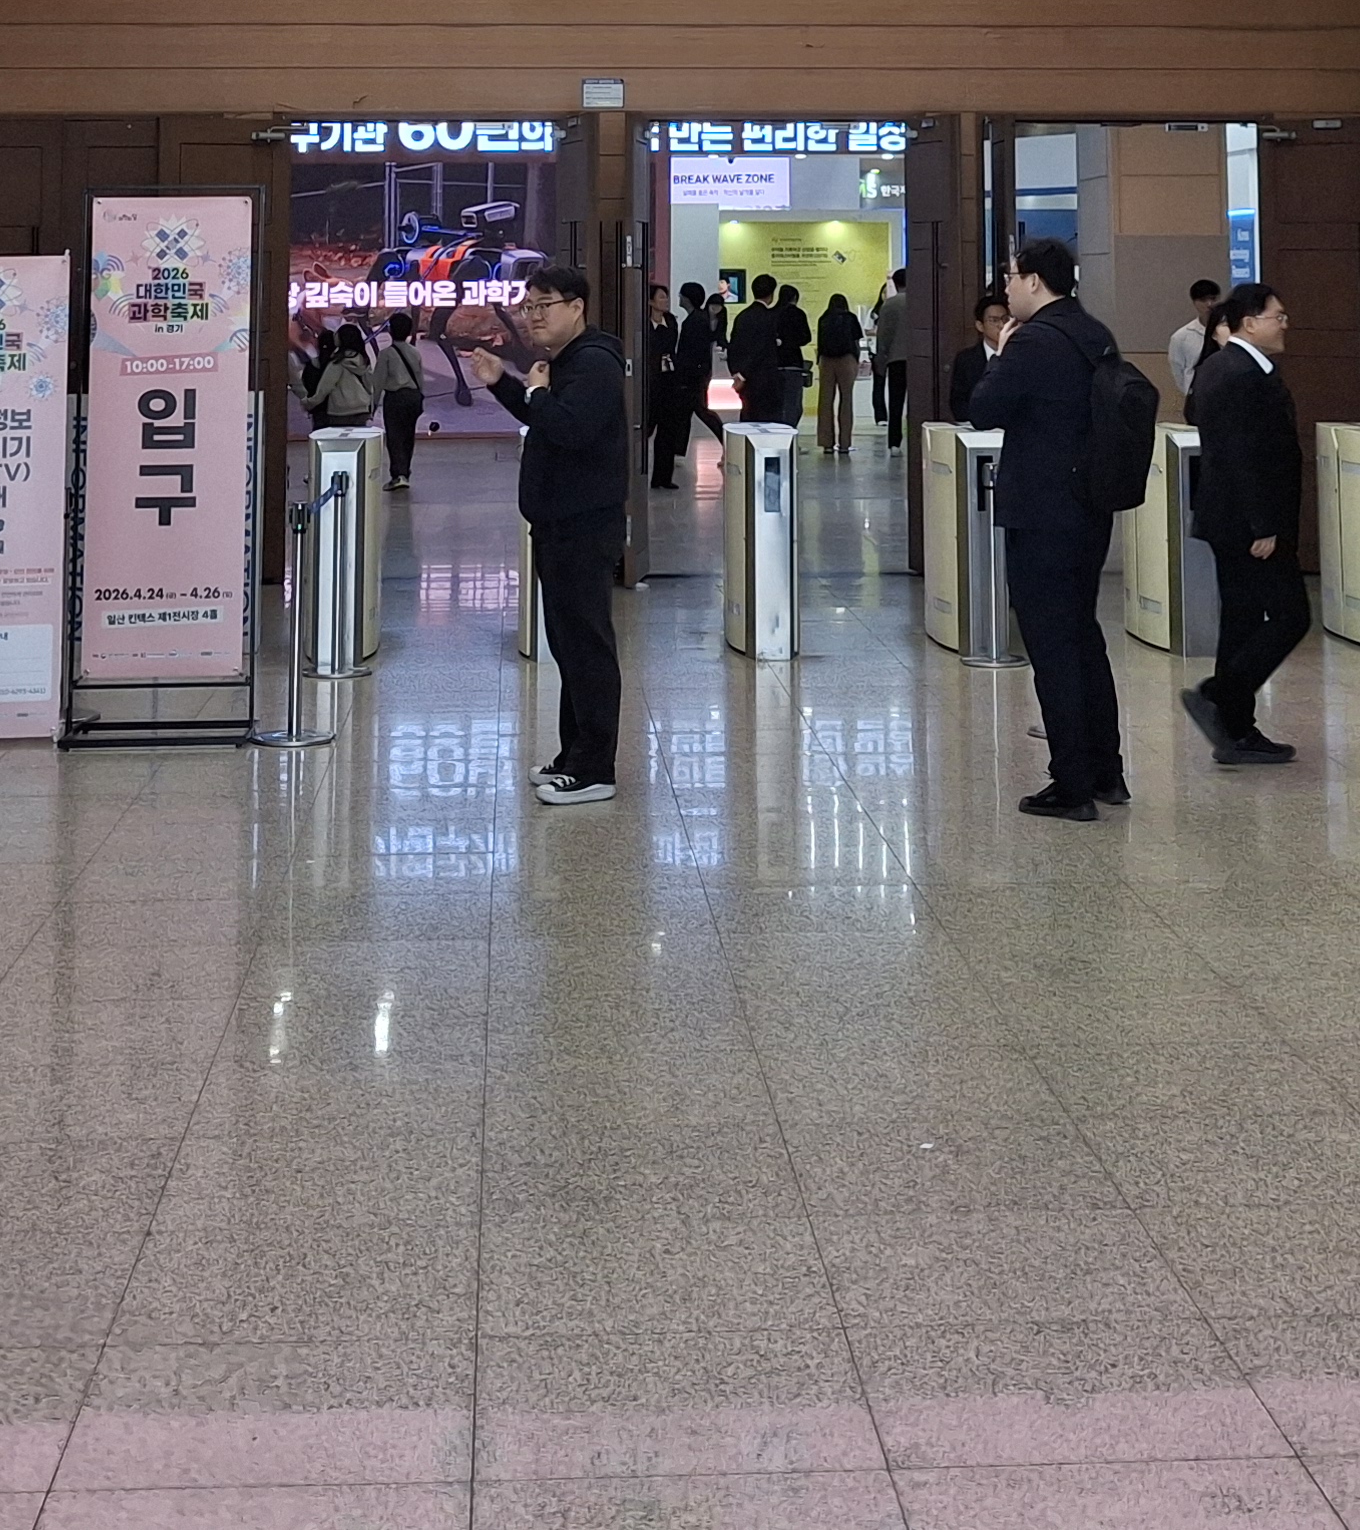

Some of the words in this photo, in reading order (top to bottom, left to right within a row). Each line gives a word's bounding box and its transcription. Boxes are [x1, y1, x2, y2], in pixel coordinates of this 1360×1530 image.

[673, 174, 710, 185] BREAK
[712, 174, 743, 184] WAVE
[745, 173, 775, 184] ZONE
[152, 268, 189, 280] 2026
[136, 282, 204, 300] 대한민국
[305, 281, 379, 308] 깊숙이
[384, 280, 456, 307] 들어온
[129, 302, 209, 321] 과학축제
[154, 325, 164, 333] in
[166, 324, 184, 334] 경기
[94, 587, 165, 602] 2026.4.24
[190, 586, 221, 600] 4.26
[107, 614, 126, 626] 일산
[128, 612, 156, 625] 킨텍스
[157, 610, 199, 623] 제1전시장
